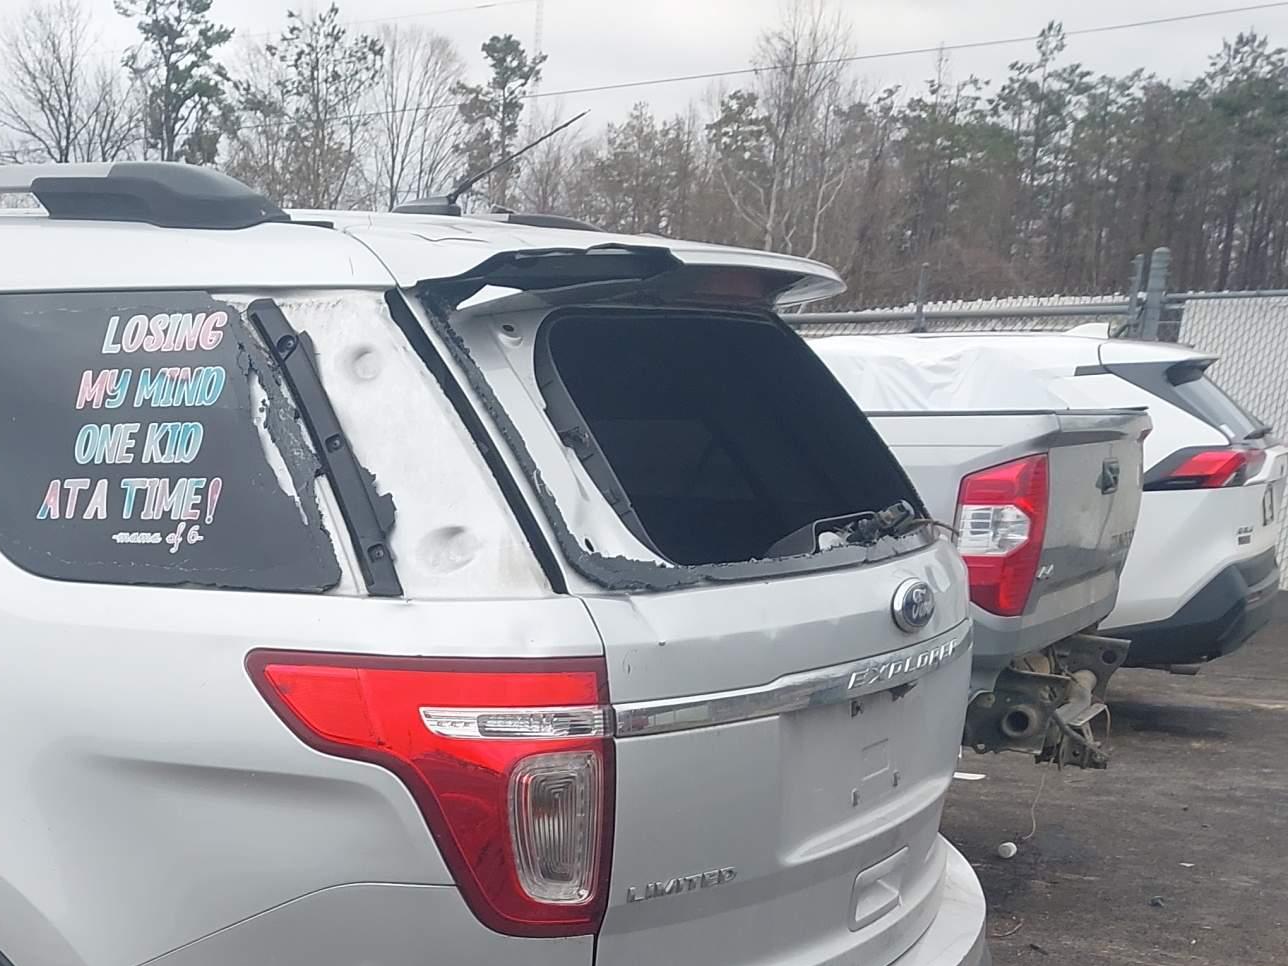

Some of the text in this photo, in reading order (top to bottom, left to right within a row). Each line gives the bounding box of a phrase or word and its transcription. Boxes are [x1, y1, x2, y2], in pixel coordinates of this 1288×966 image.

[102, 311, 228, 353] LOSING
[76, 366, 226, 409] MY MIND
[74, 421, 203, 464] ONE KID
[121, 477, 223, 524] TIME!
[166, 521, 186, 553] of
[847, 638, 957, 690] EXPLORER
[626, 867, 737, 904] LIMITED
